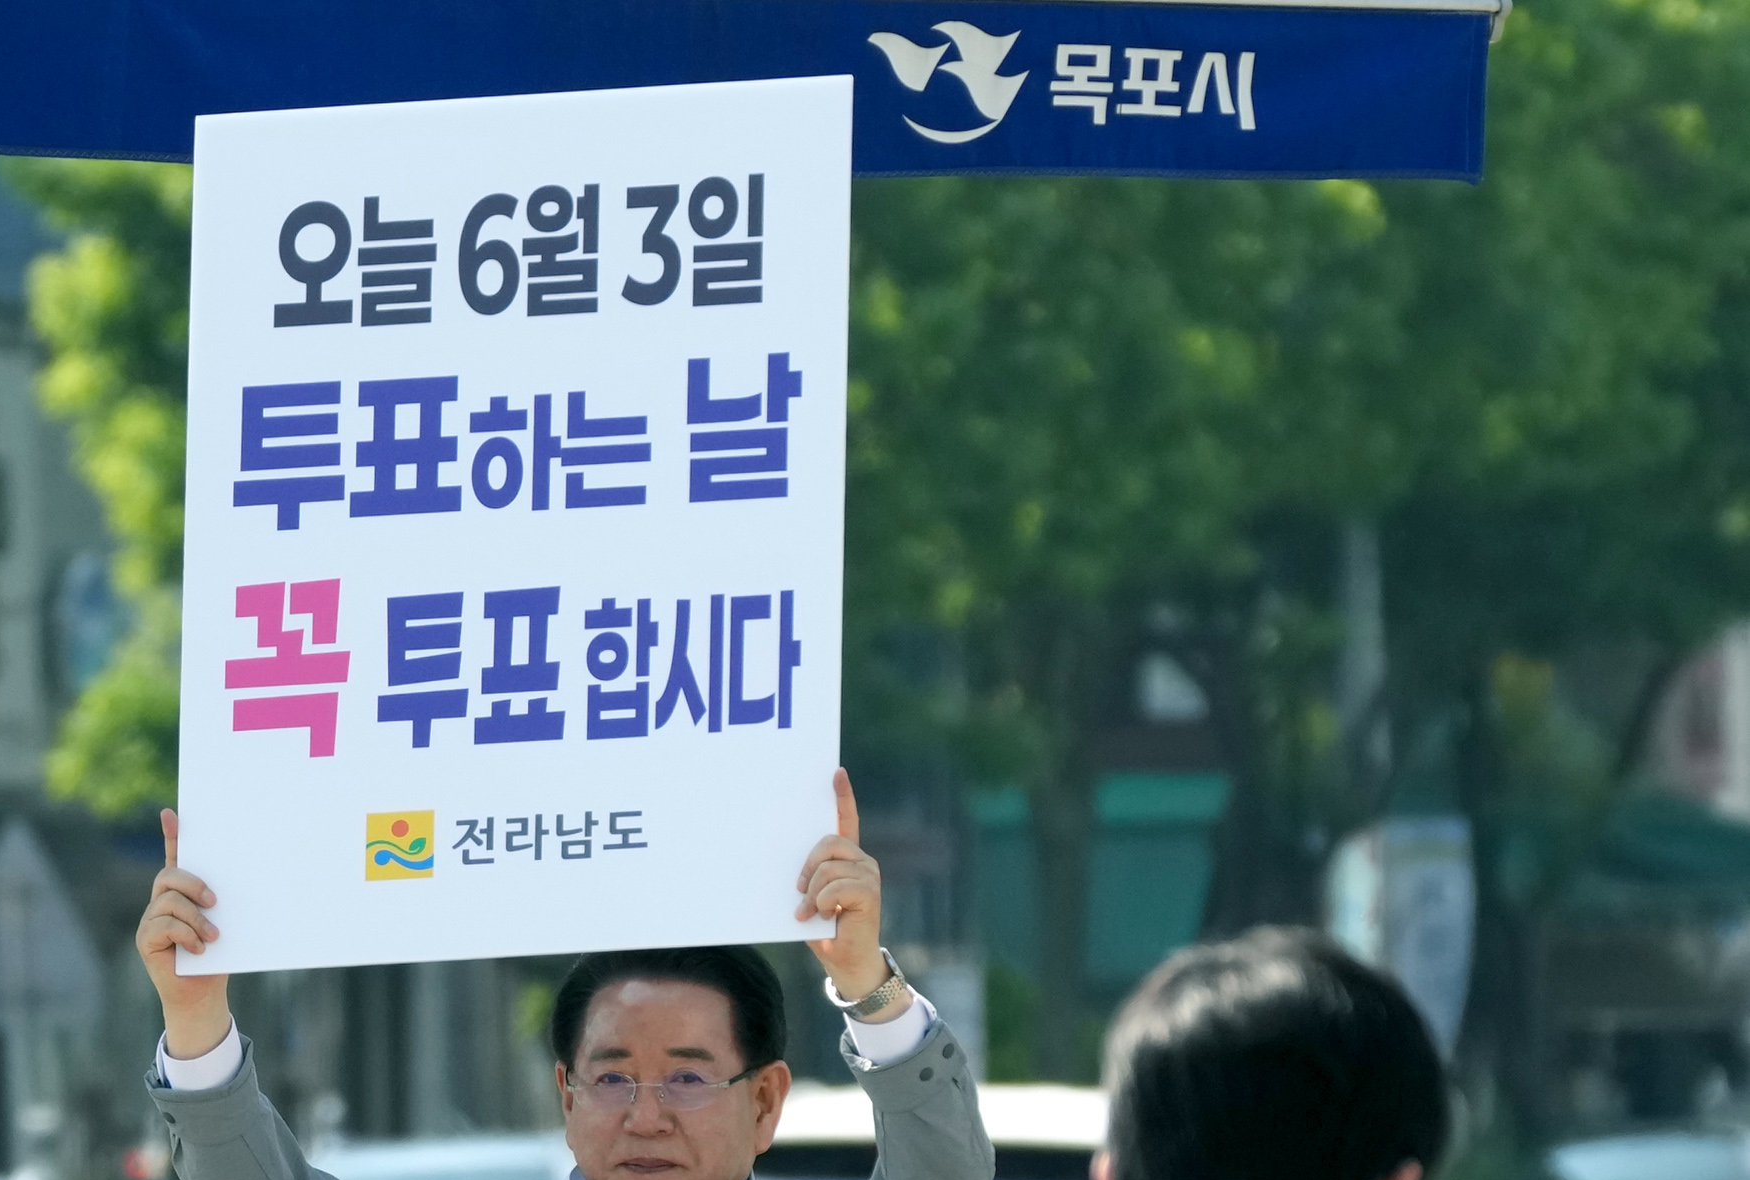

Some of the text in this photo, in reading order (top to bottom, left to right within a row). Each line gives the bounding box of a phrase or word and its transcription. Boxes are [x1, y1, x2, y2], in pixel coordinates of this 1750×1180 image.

[1050, 44, 1256, 130] 목포시
[273, 173, 765, 328] 오늘 6월 3일
[233, 352, 803, 531] 투표하는 날
[224, 578, 351, 758] 꼭
[452, 811, 648, 865] 전라남도
